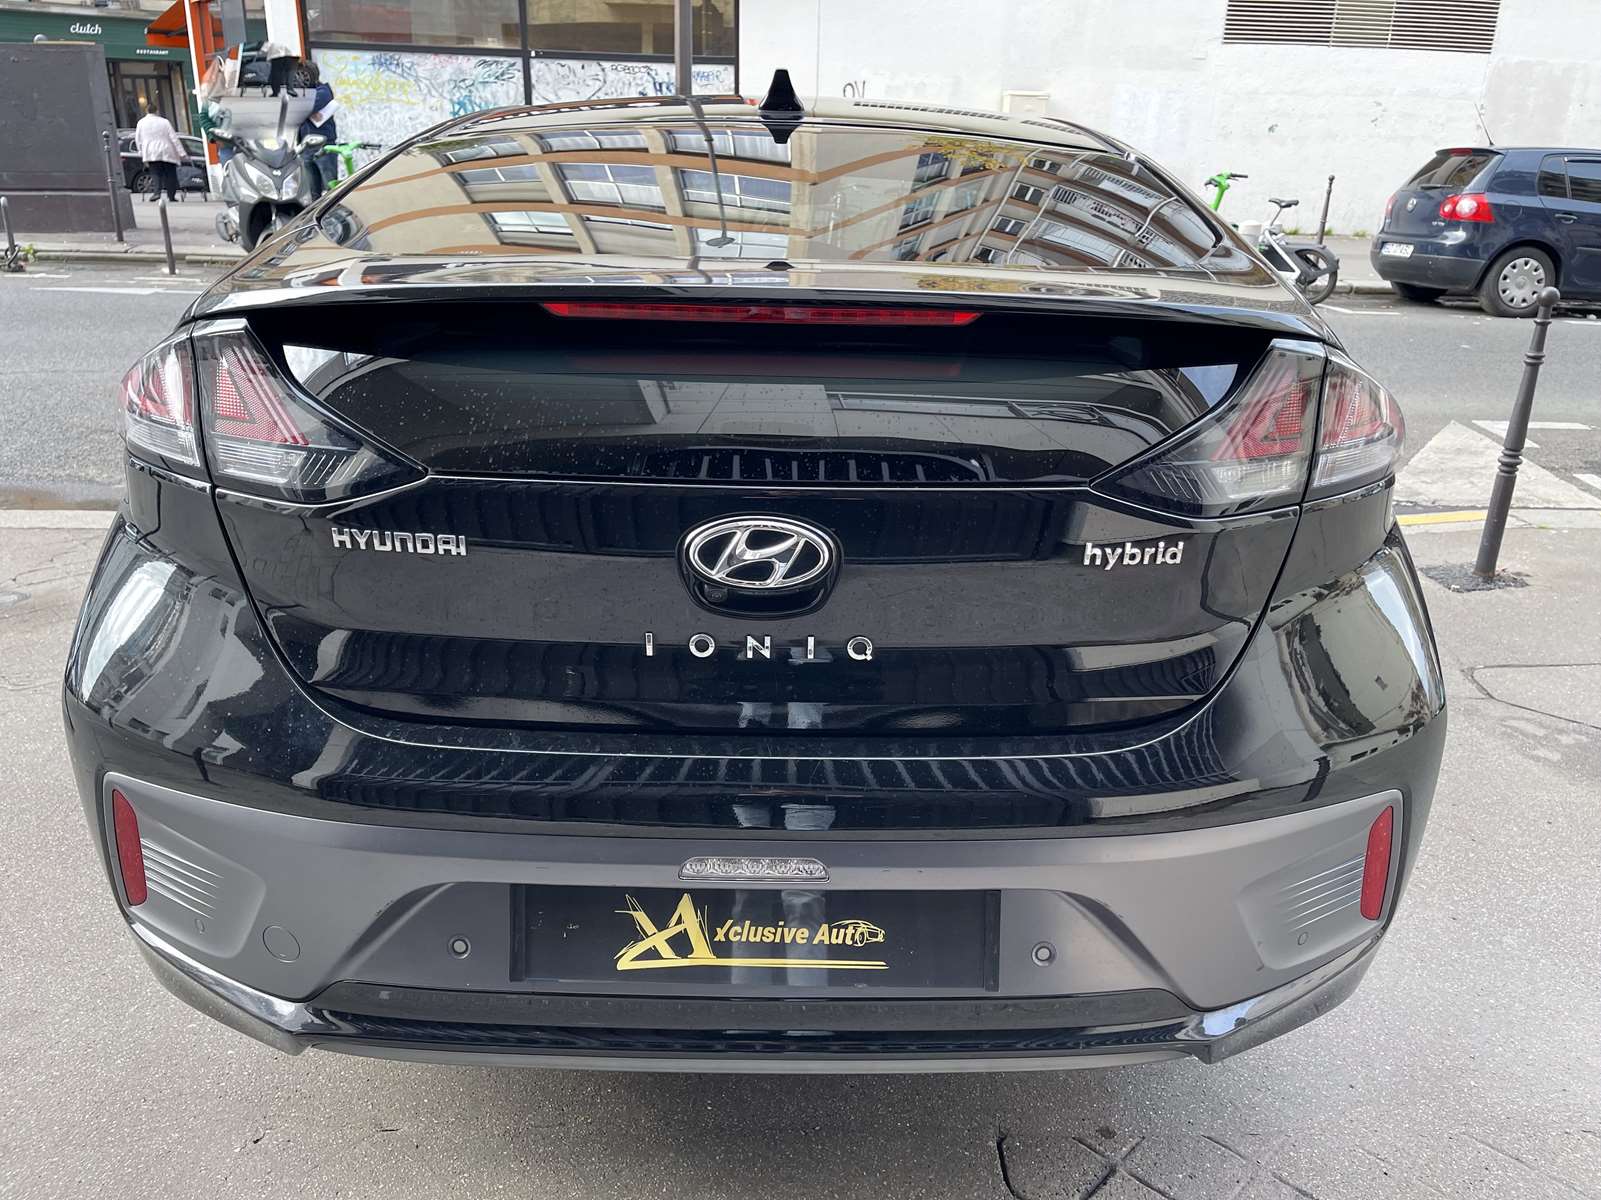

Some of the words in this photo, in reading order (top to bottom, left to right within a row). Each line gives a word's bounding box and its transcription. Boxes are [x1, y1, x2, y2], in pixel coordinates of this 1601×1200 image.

[70, 22, 102, 35] clutch
[331, 527, 467, 556] HYUNDAI
[1083, 541, 1184, 571] hybrid
[645, 632, 873, 661] IONIQ
[713, 919, 808, 944] Xclusive
